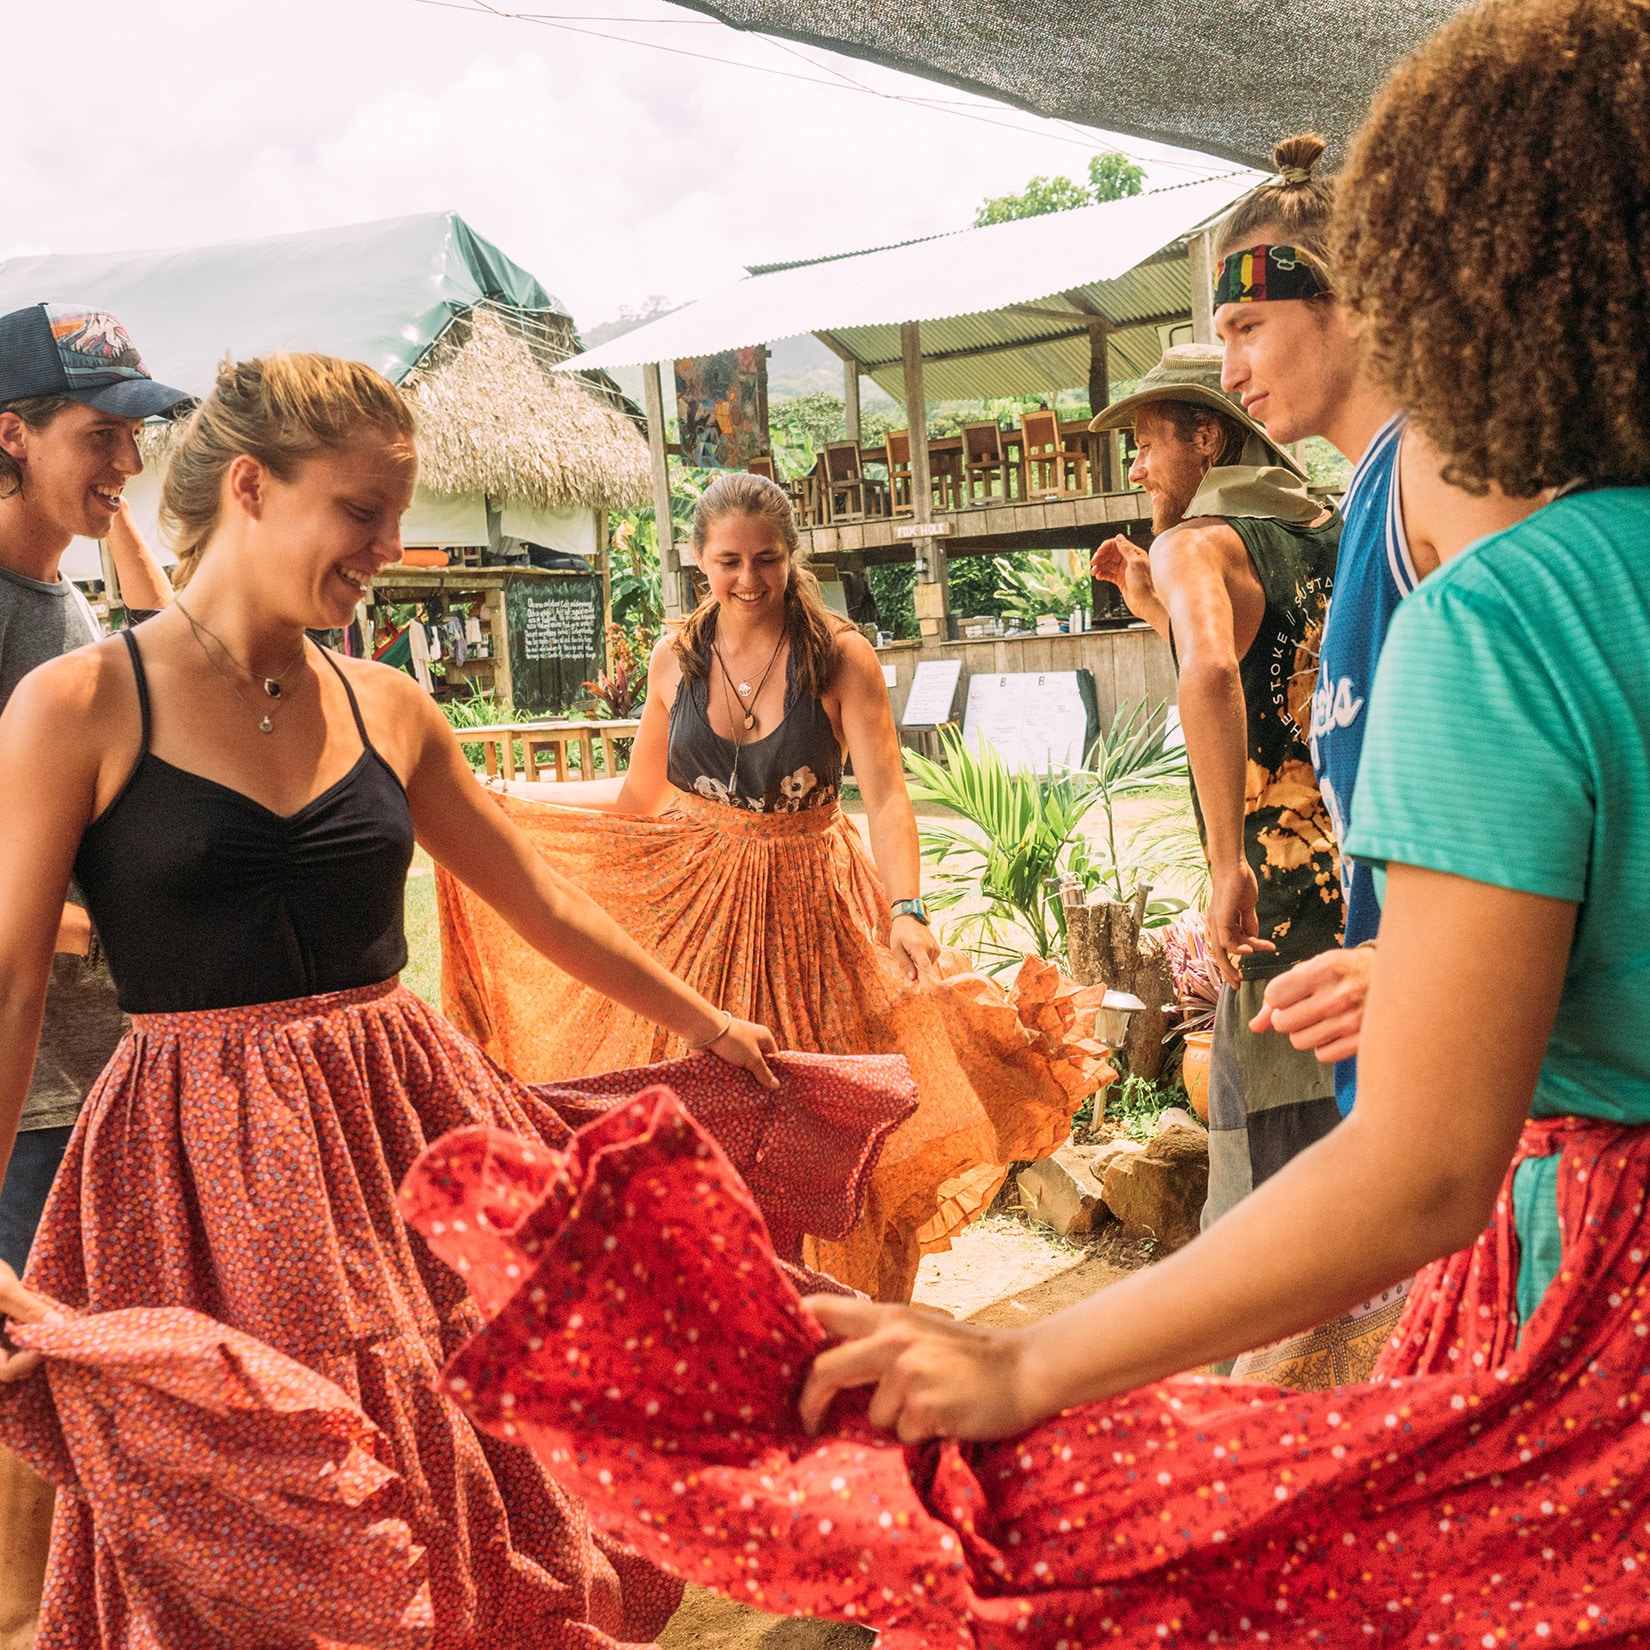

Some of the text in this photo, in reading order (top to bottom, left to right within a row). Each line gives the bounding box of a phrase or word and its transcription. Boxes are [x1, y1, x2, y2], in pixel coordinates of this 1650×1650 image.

[897, 523, 944, 538] FOX HOLE
[1271, 632, 1288, 704] STOKE
